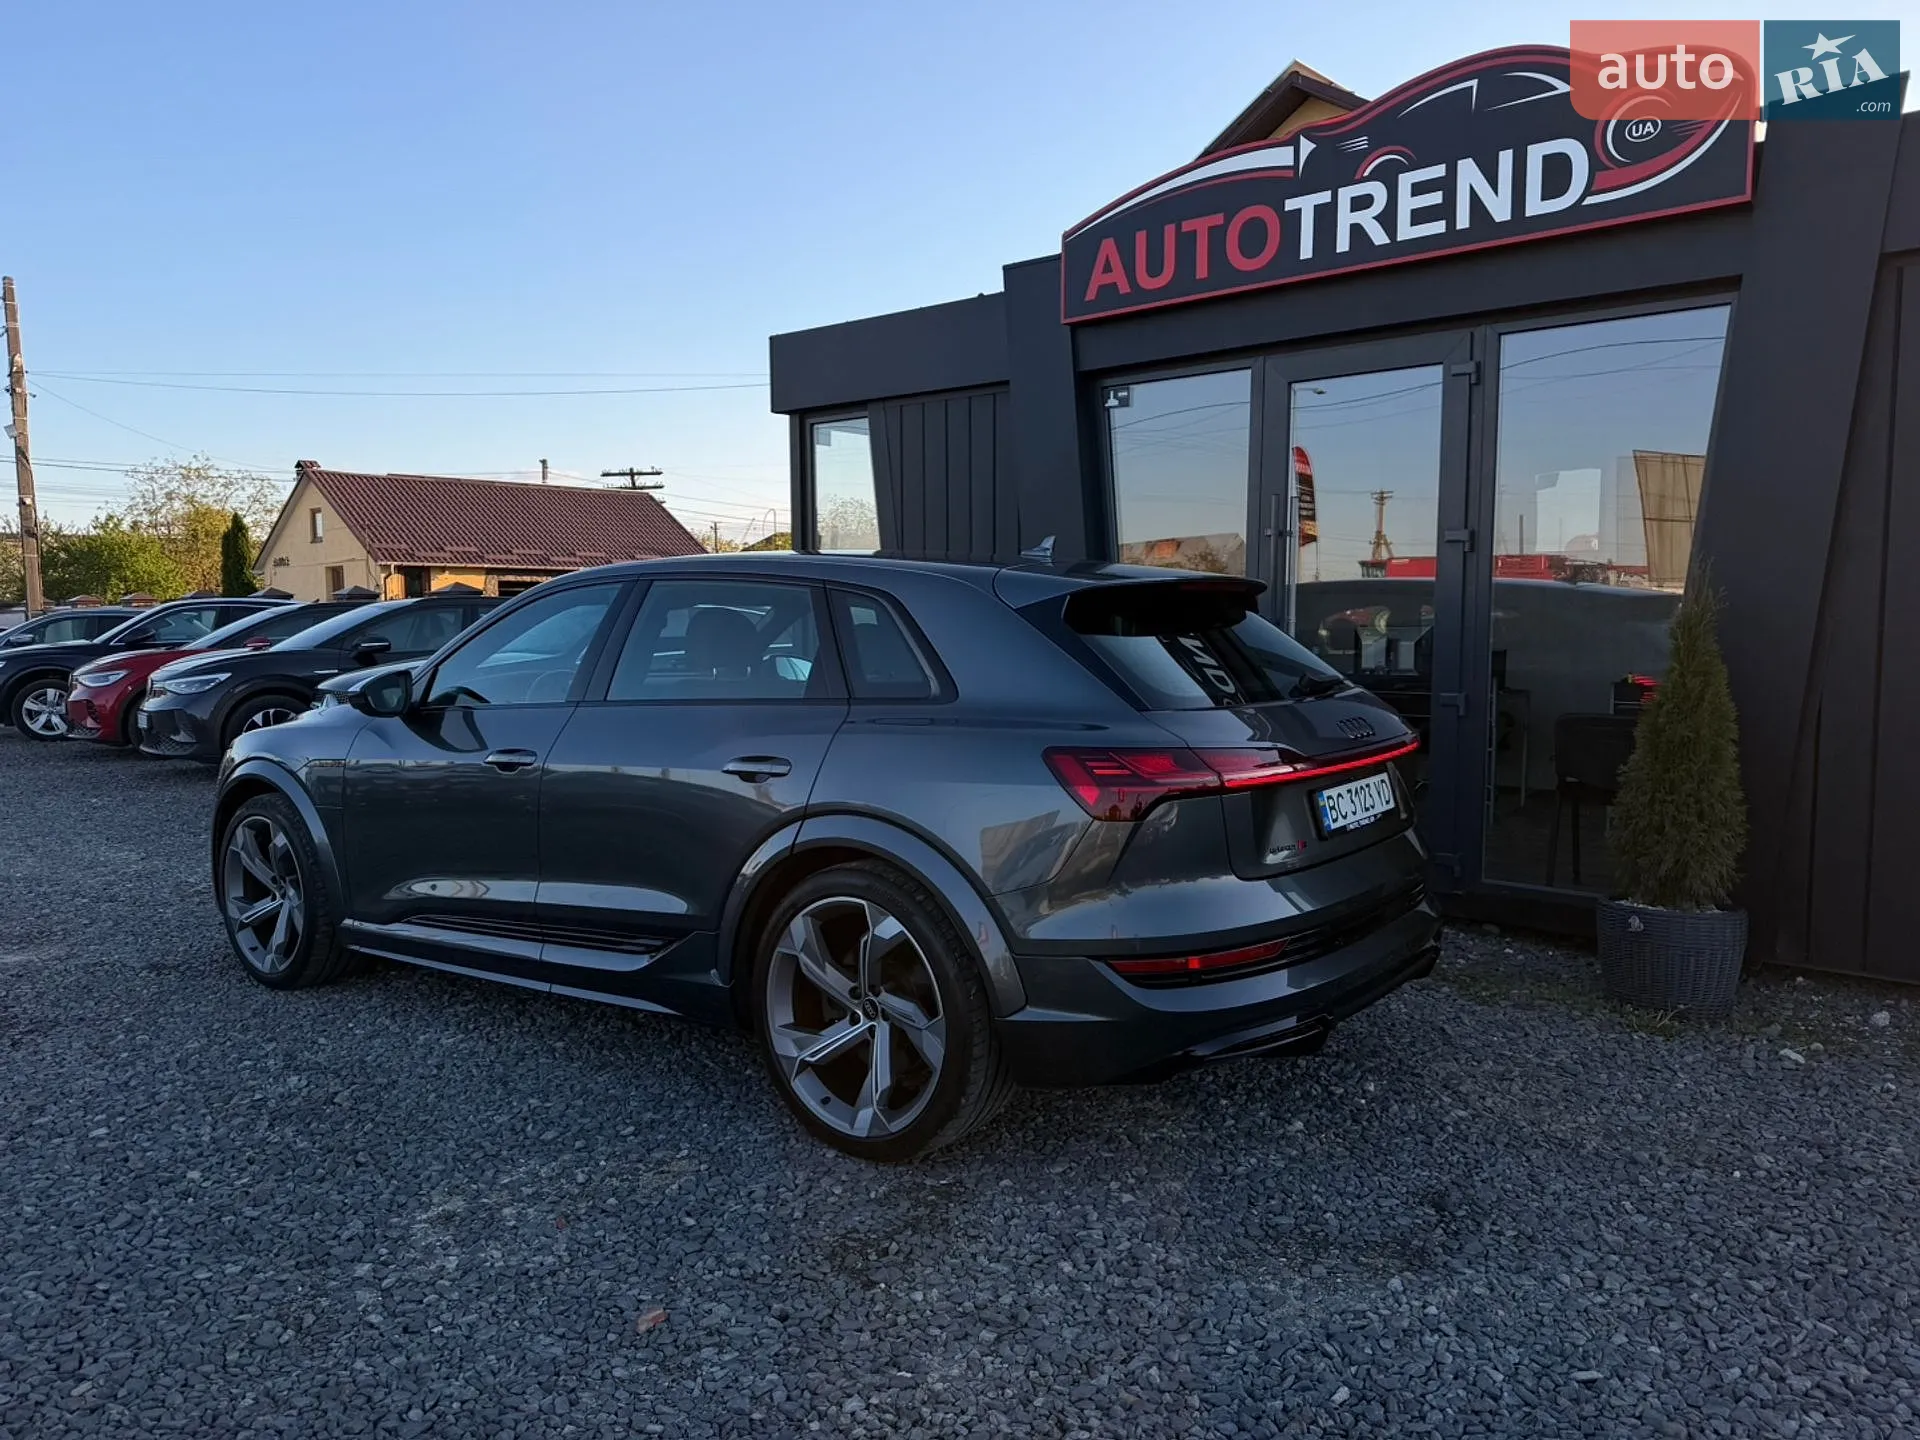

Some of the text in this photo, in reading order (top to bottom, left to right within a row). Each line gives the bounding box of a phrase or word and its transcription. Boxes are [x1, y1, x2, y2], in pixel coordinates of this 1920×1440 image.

[1631, 123, 1656, 138] UA
[1326, 792, 1348, 824] BC
[1346, 783, 1375, 816] 3123
